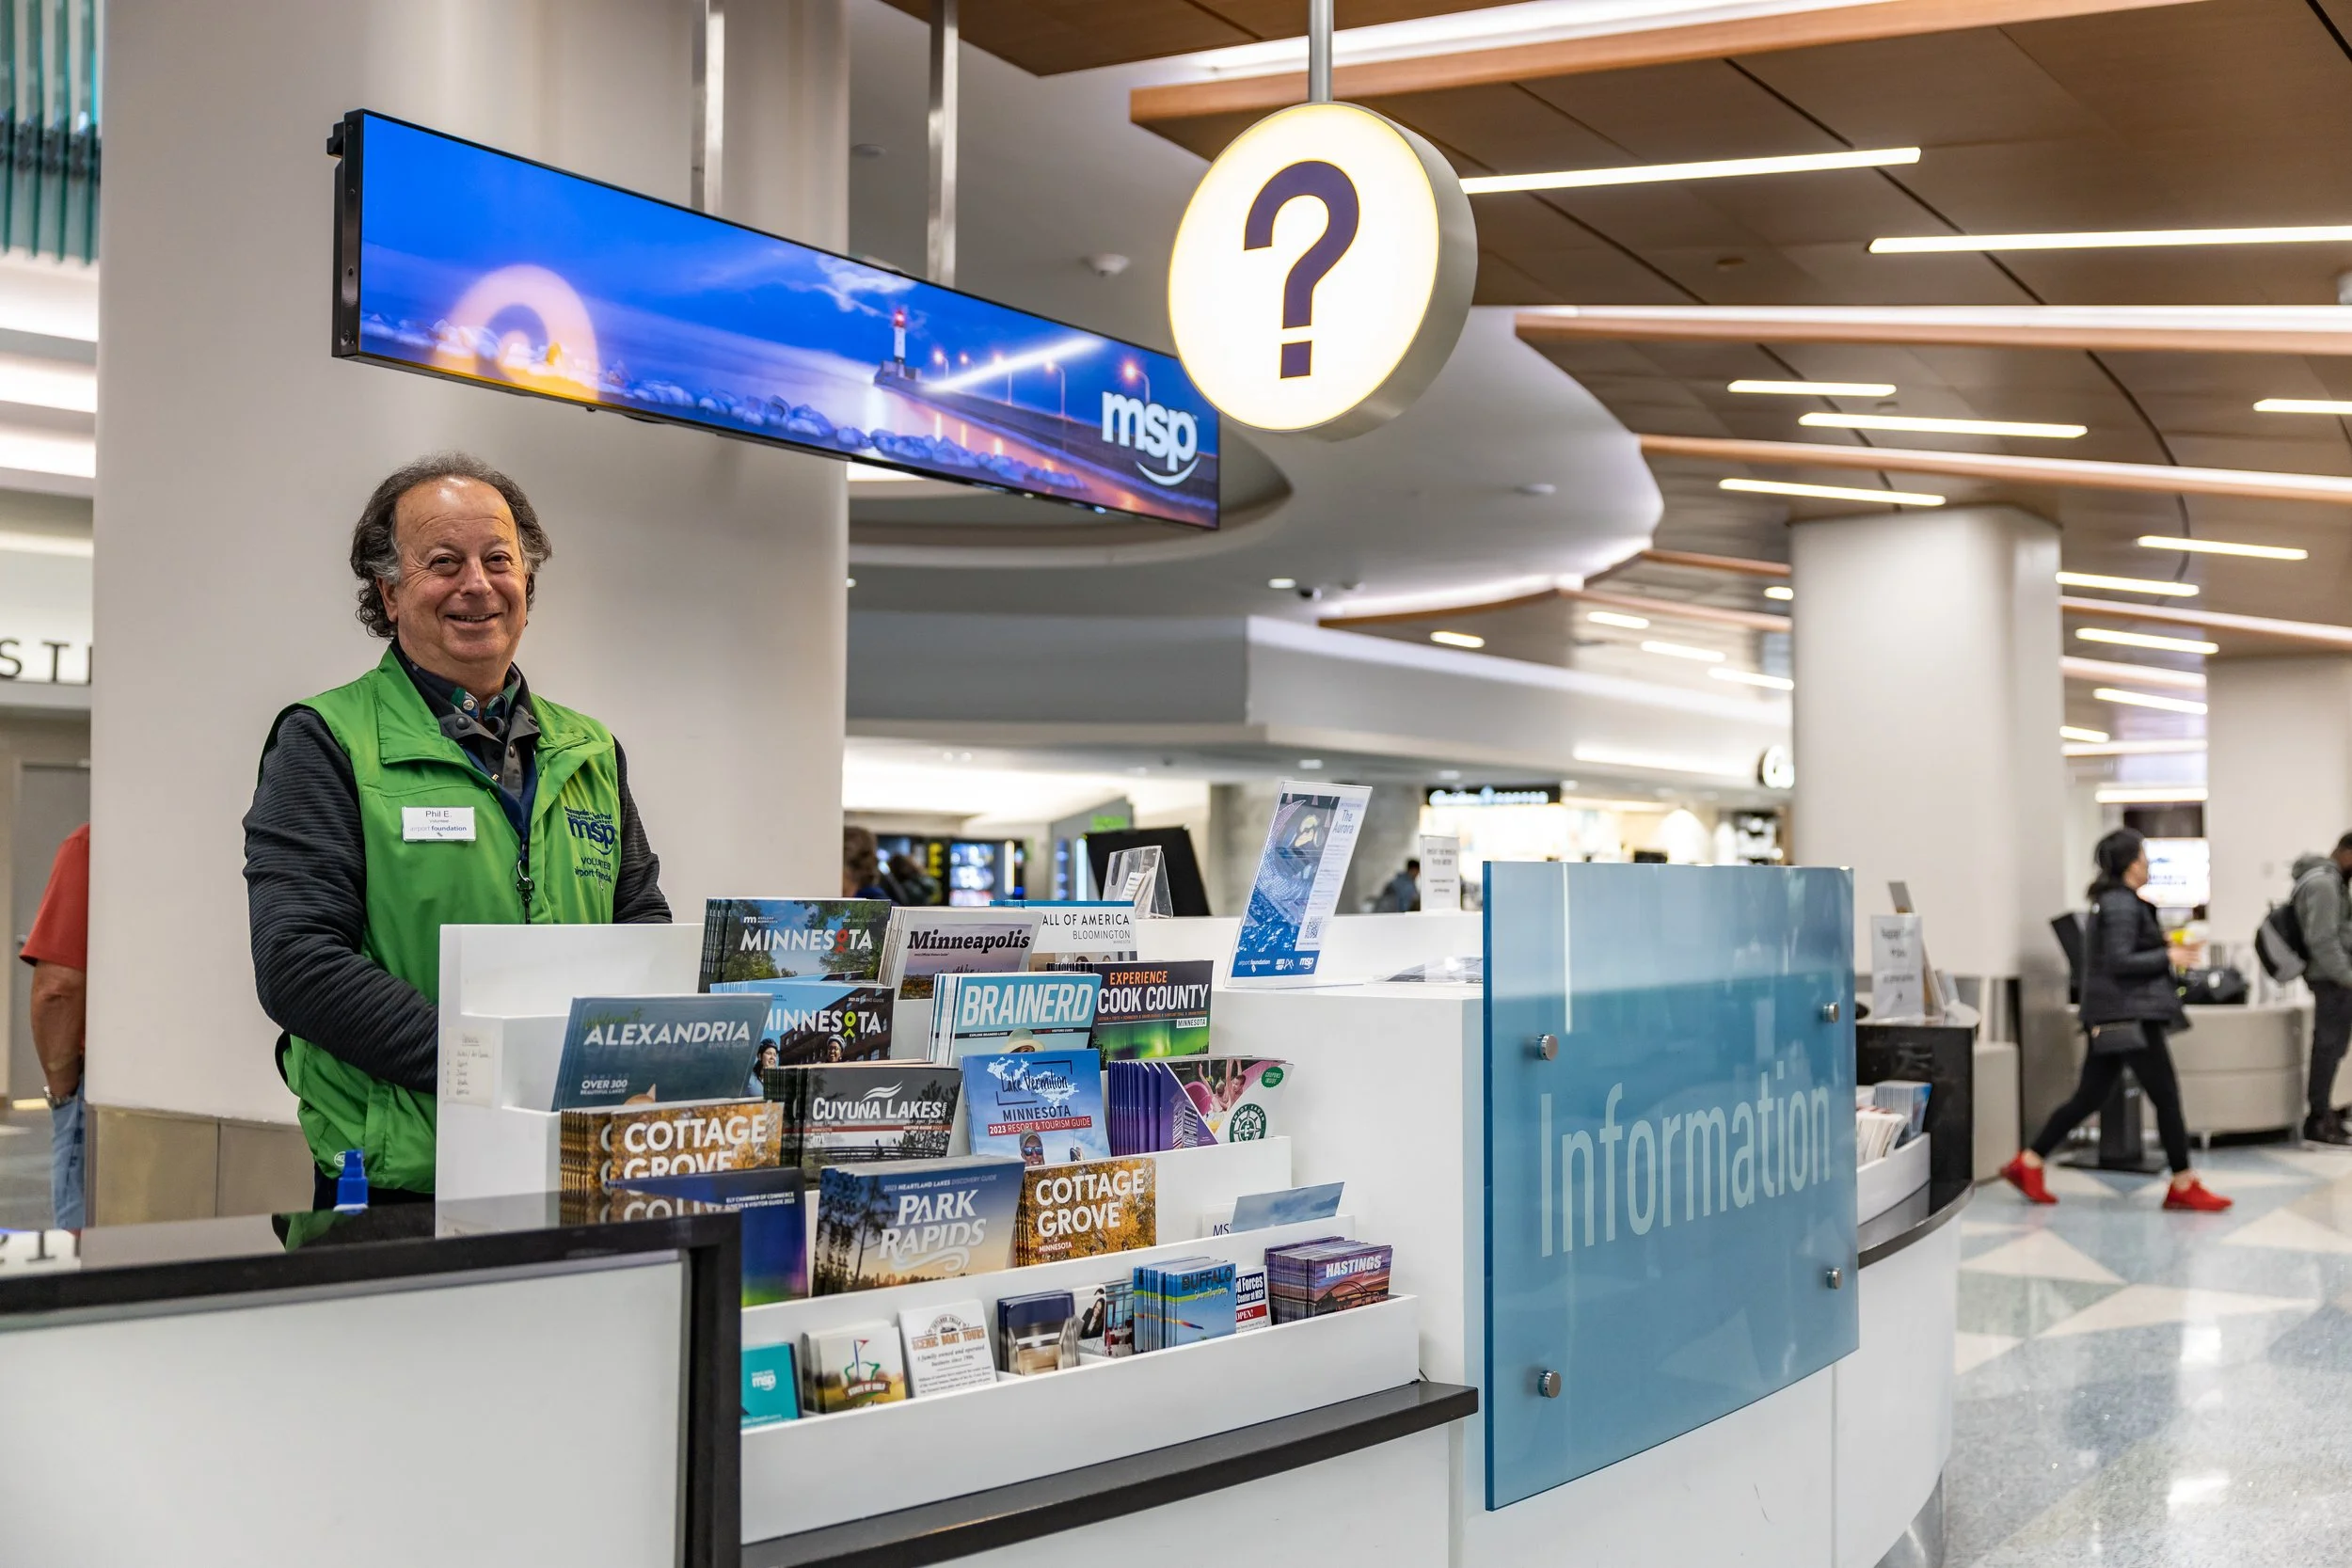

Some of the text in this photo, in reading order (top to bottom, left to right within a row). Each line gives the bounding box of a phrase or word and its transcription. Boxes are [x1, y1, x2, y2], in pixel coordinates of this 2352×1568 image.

[1102, 391, 1198, 472] msp
[1342, 809, 1354, 822] The
[567, 817, 616, 849] msp
[1332, 821, 1355, 834] Aurora
[1041, 913, 1130, 926] ALL OF AMERICA
[739, 928, 873, 953] MINNESOTA
[907, 928, 1031, 954] Minneapolis
[1073, 929, 1131, 940] BLOOMINGTON
[1299, 957, 1314, 966] msp
[1110, 971, 1168, 986] EXPERIENCE
[961, 983, 1093, 1027] BRAINERD
[1097, 983, 1209, 1014] COOK COUNTY
[583, 1021, 751, 1046] ALEXANDRIA
[1178, 1018, 1206, 1027] MINNESOTA
[581, 1079, 628, 1089] OVER 300
[1000, 1069, 1068, 1093] Lake Vermilion
[812, 1096, 881, 1120] CUYUNA
[885, 1098, 942, 1119] LAKES
[1003, 1104, 1072, 1122] MINNESOTA
[624, 1114, 769, 1153] COTTAGE
[989, 1117, 1091, 1135] 2023 RESORT & TOURISM GUIDE
[624, 1150, 733, 1180] GROVE
[1540, 1060, 1831, 1258] Information
[898, 1181, 933, 1191] HEARTLAND
[933, 1179, 951, 1188] LAKES
[980, 1174, 997, 1182] GUIDE
[1036, 1168, 1145, 1206] COTTAGE
[896, 1189, 979, 1227] PARK
[1038, 1201, 1120, 1238] GROVE
[878, 1218, 987, 1259] RAPIDS
[1039, 1242, 1073, 1253] MINNESOTA
[1326, 1255, 1382, 1278] HASTINGS
[1181, 1266, 1233, 1291] BUFFALO
[1242, 1275, 1263, 1292] Forces
[1237, 1289, 1263, 1304] Center at MSP
[941, 1332, 960, 1346] BOAT
[962, 1328, 985, 1342] TOURS
[921, 1354, 937, 1363] family
